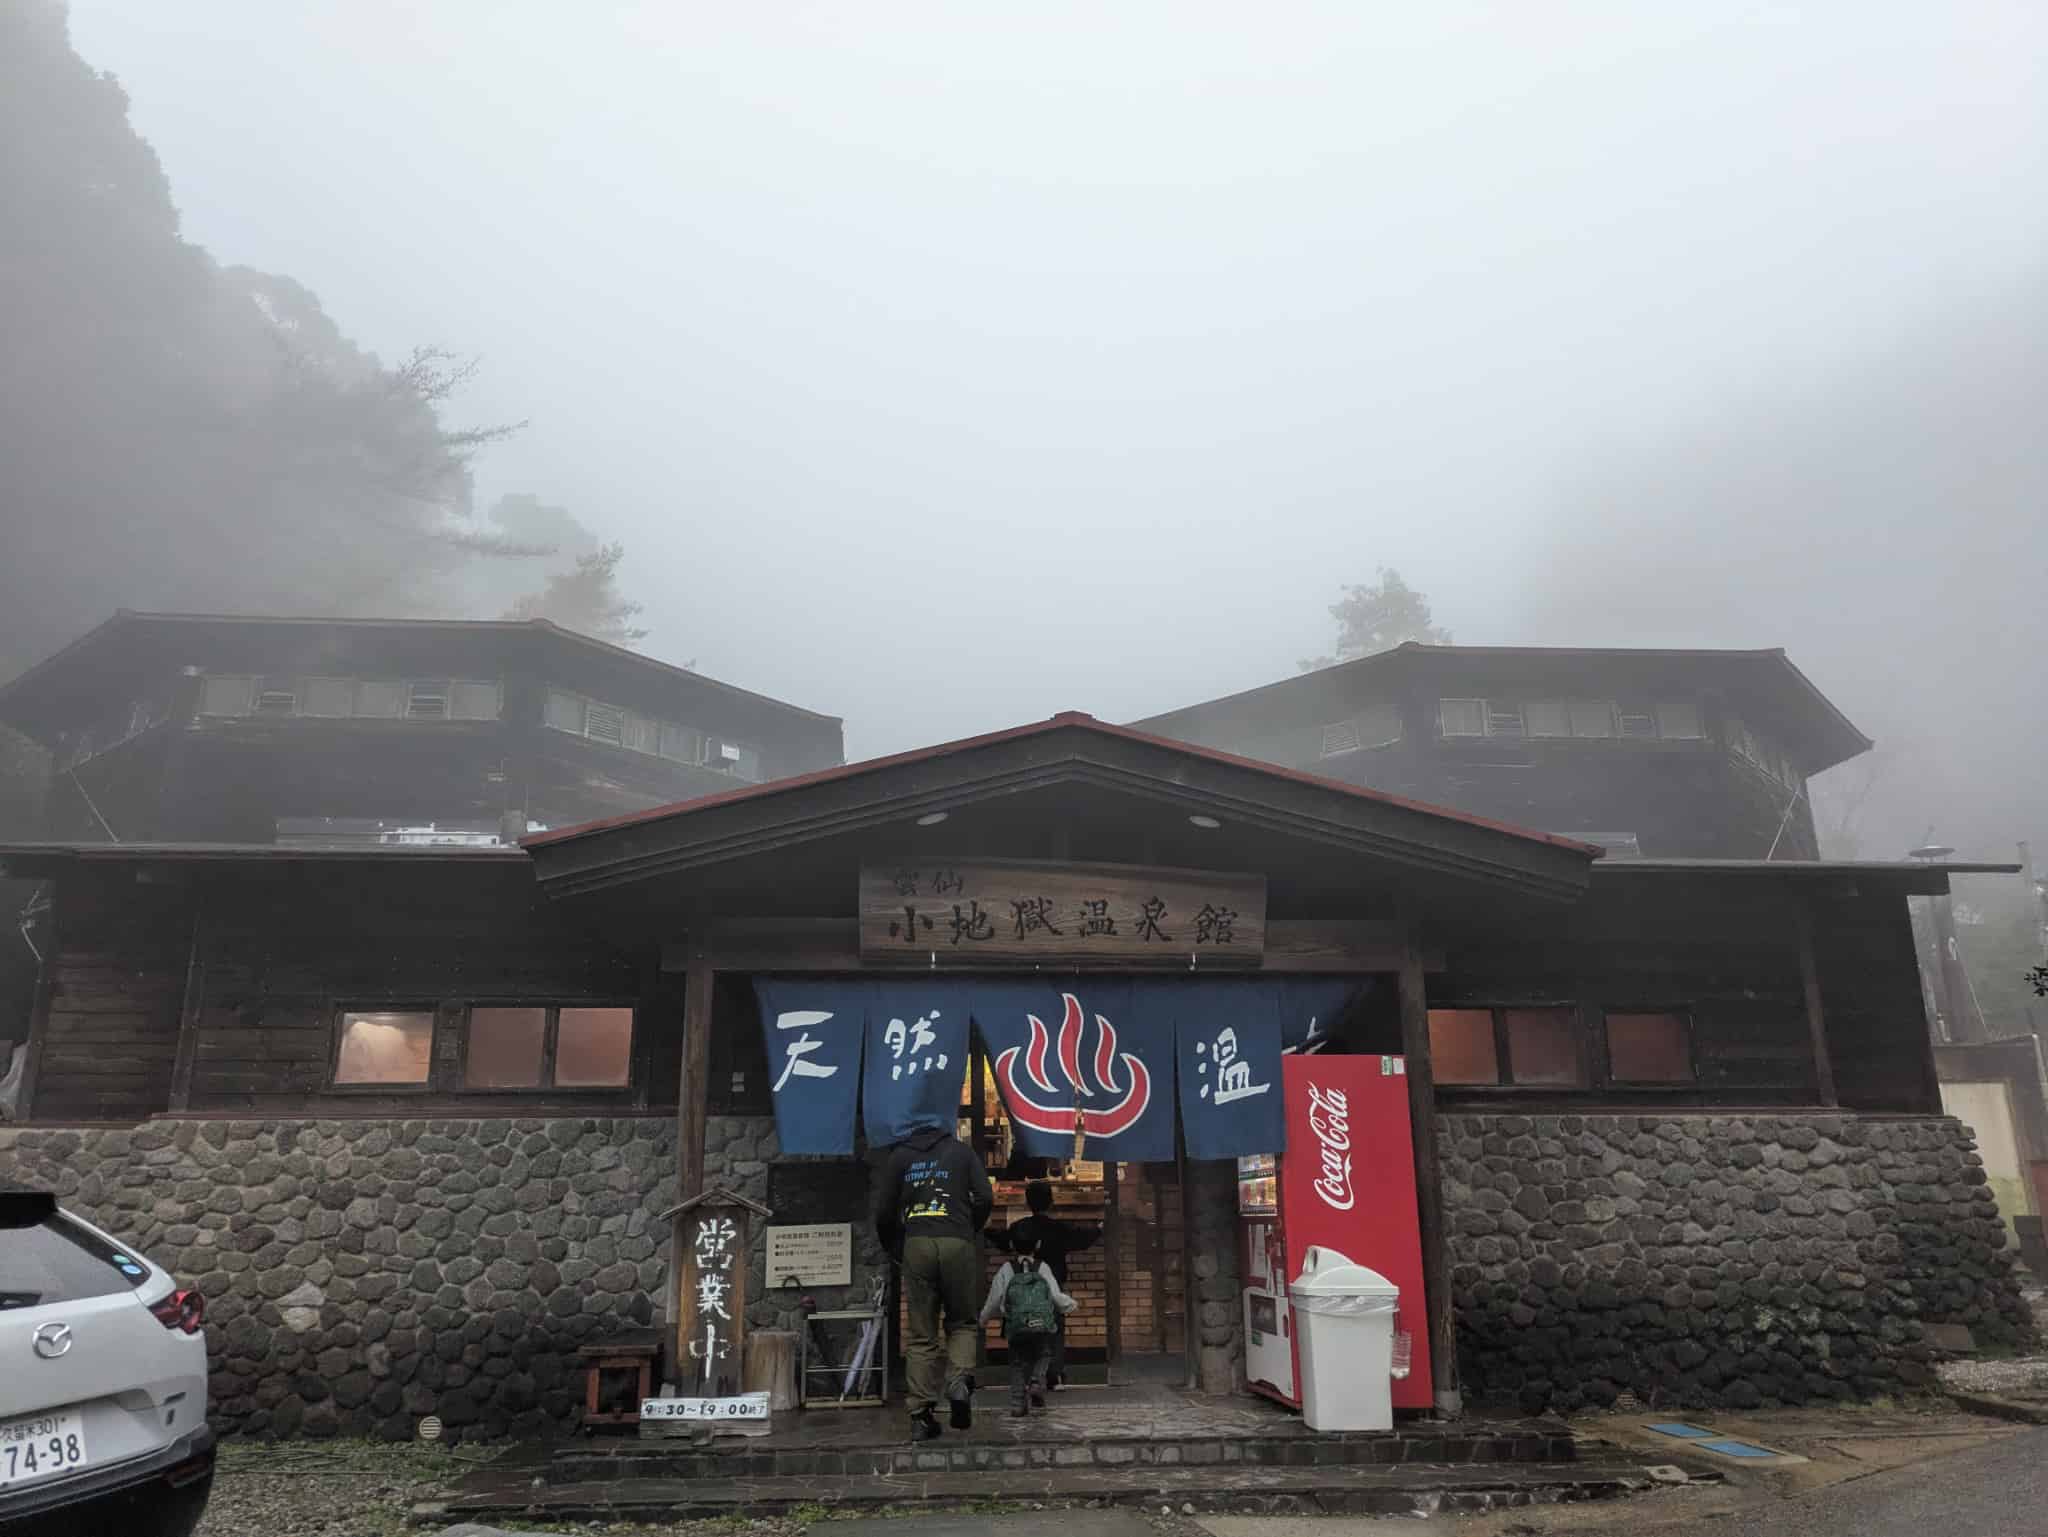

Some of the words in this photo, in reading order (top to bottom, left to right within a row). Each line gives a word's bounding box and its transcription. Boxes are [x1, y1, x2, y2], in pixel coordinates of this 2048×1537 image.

[889, 895, 1240, 945] 小地獄温泉館
[689, 1218, 737, 1381] 営業中
[4, 1433, 80, 1478] 74-98
